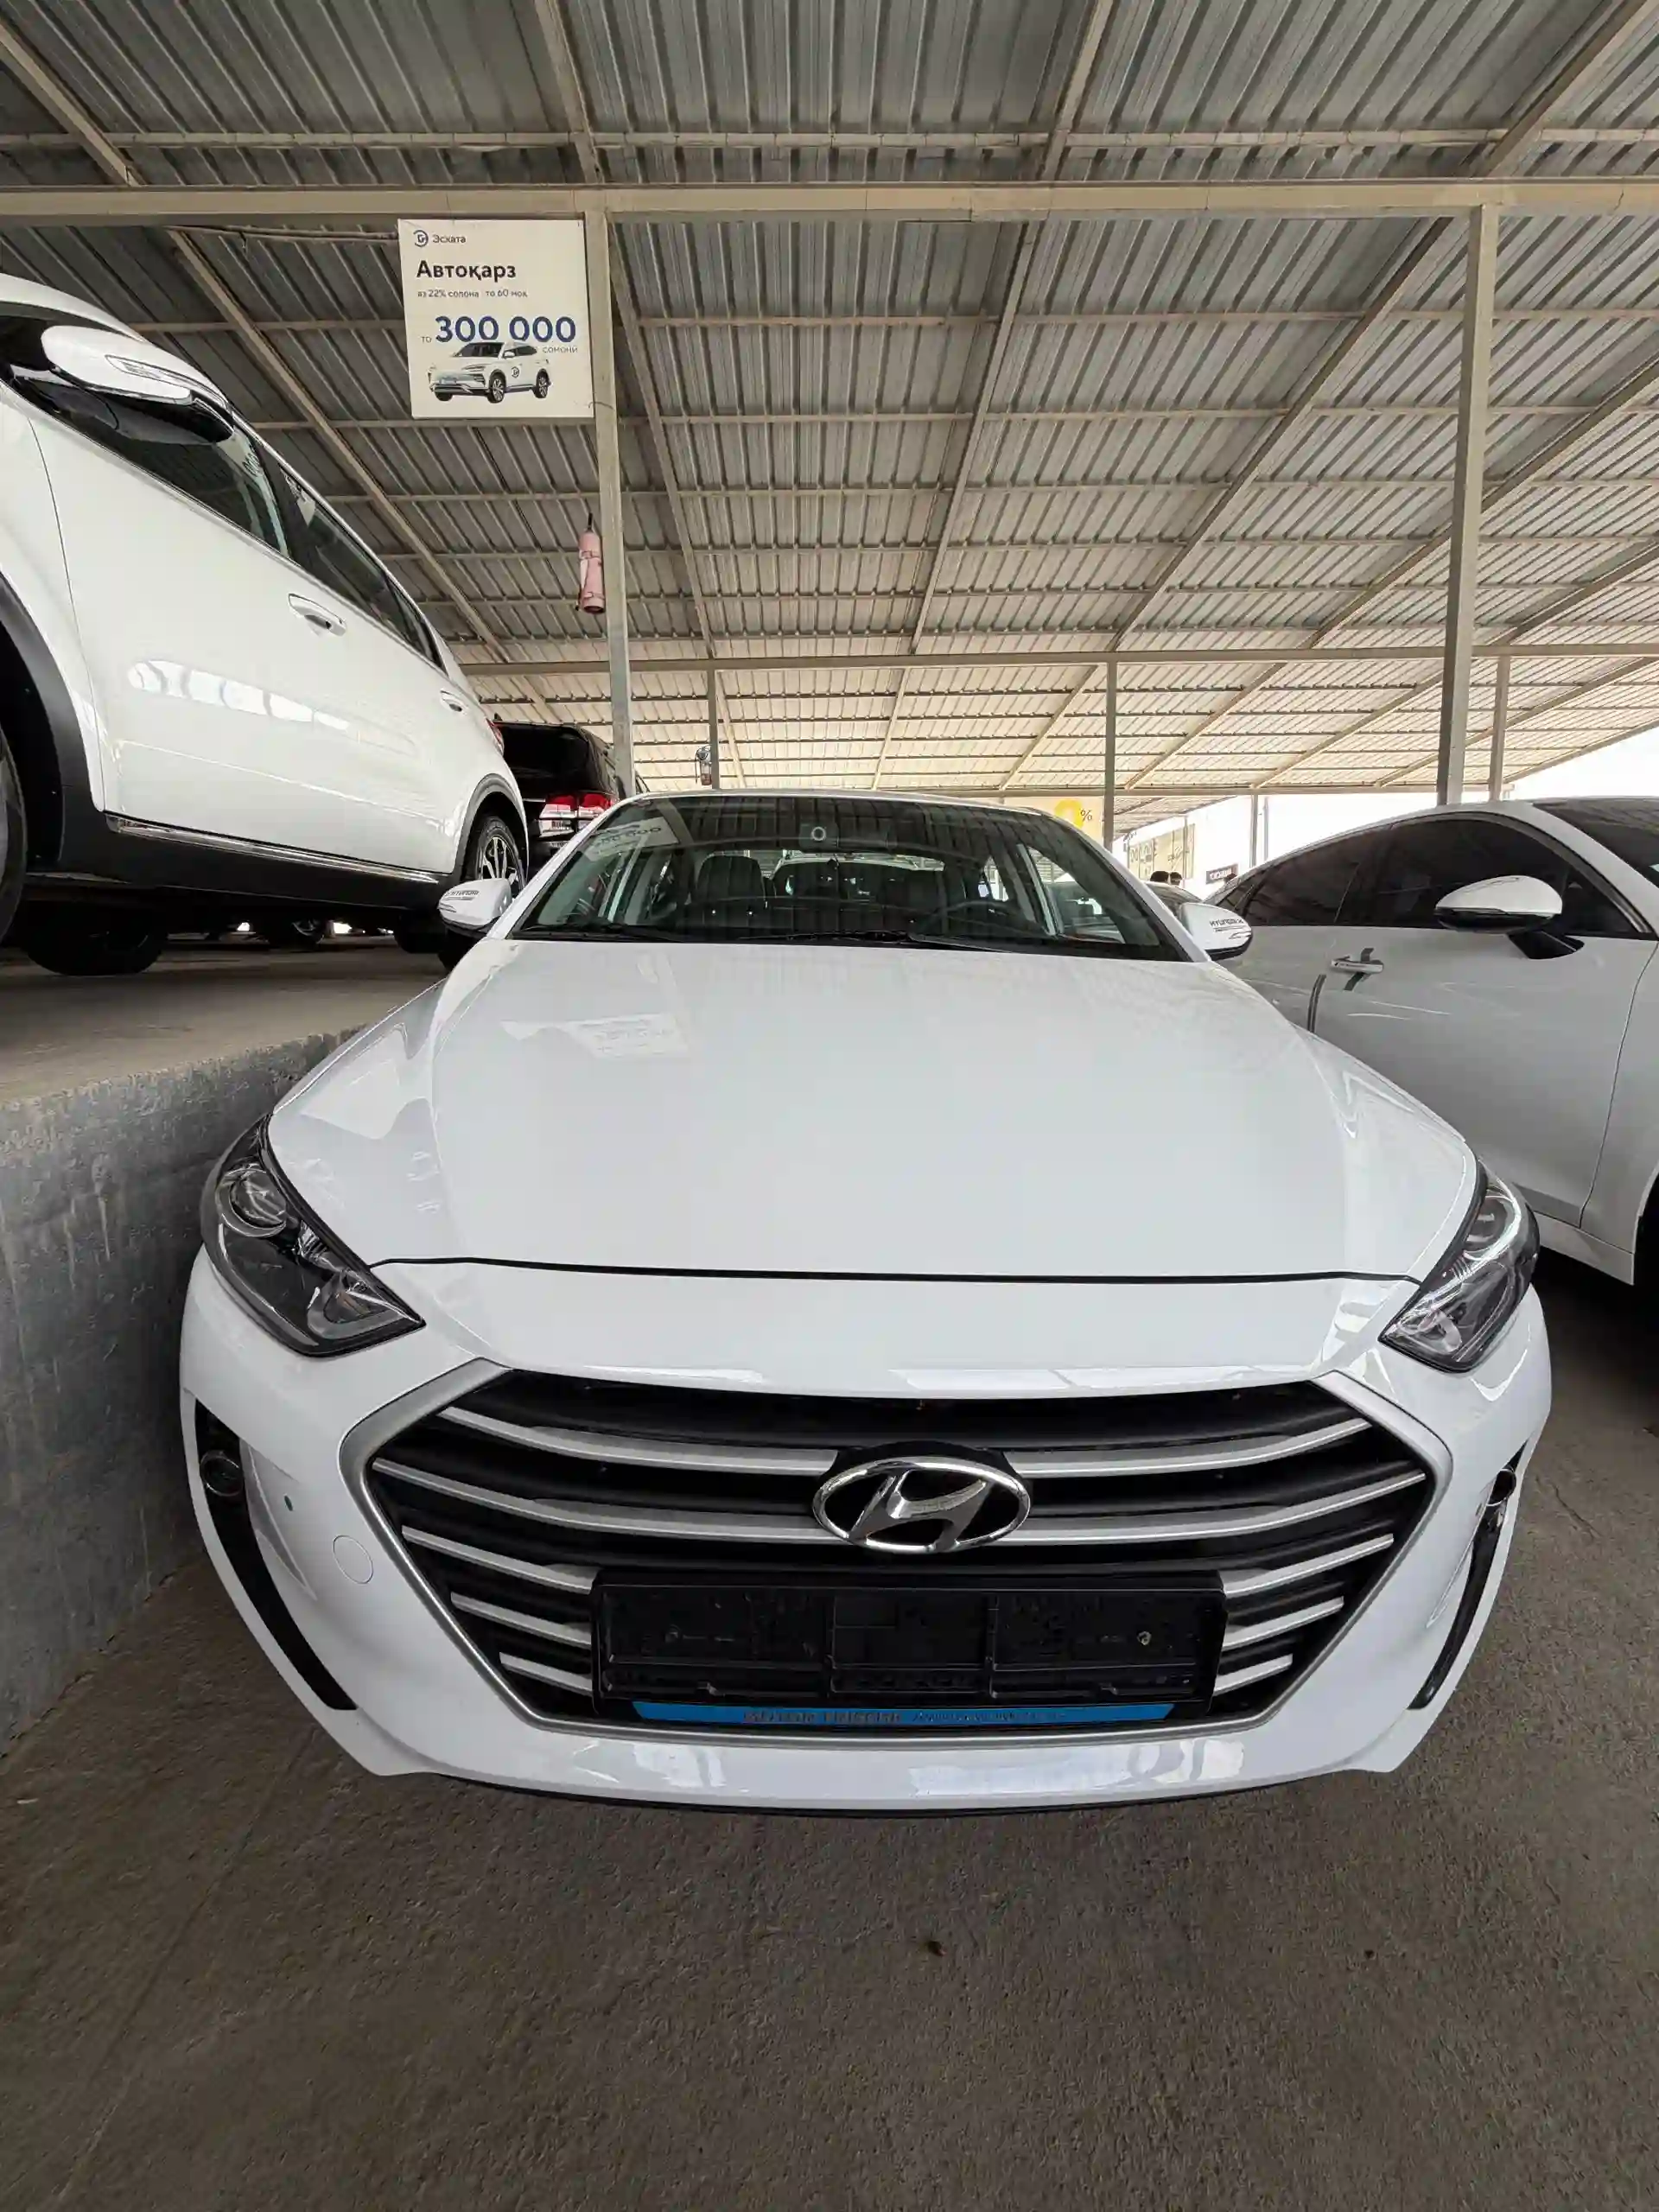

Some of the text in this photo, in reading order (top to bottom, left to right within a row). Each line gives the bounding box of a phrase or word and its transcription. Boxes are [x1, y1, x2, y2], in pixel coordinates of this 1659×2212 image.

[432, 233, 467, 244] Эсхата
[416, 259, 517, 283] Автоқарз
[429, 289, 447, 297] 22%
[498, 289, 509, 297] 60
[435, 316, 499, 342] 300
[509, 316, 575, 342] 000
